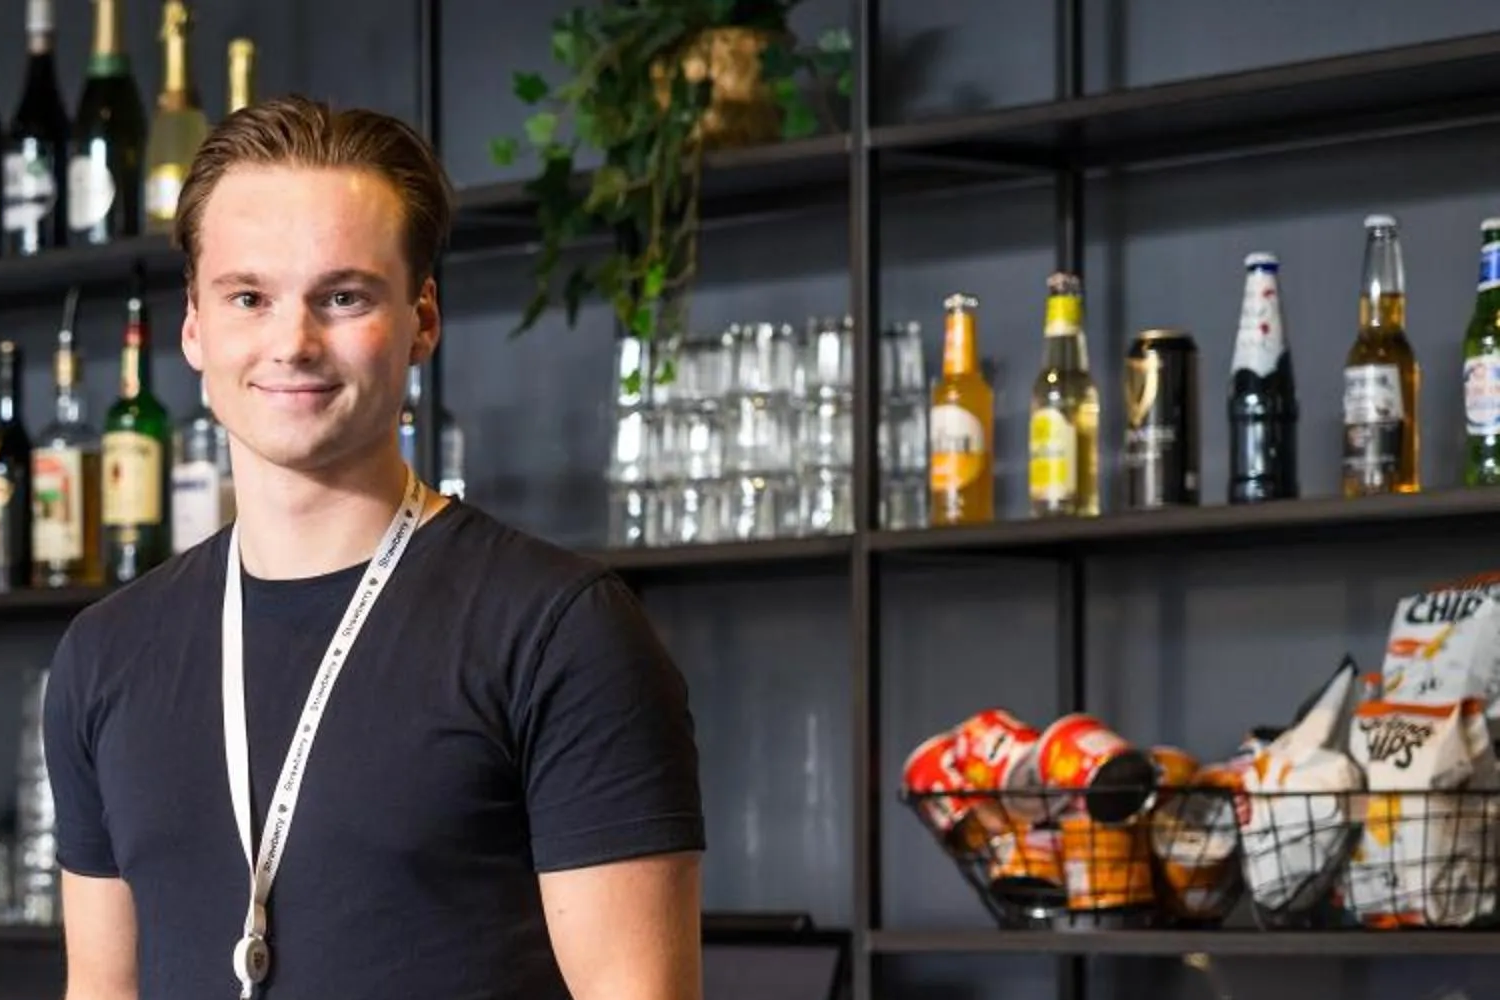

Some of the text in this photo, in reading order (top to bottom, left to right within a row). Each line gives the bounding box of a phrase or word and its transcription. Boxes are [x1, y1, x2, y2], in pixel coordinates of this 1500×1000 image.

[378, 522, 409, 569] Strawberry
[342, 590, 373, 637] Strawberry
[1405, 590, 1486, 624] CHIP
[310, 661, 338, 712] Strawberry
[283, 737, 309, 792] Strawberry
[263, 817, 287, 873] Strawberry
